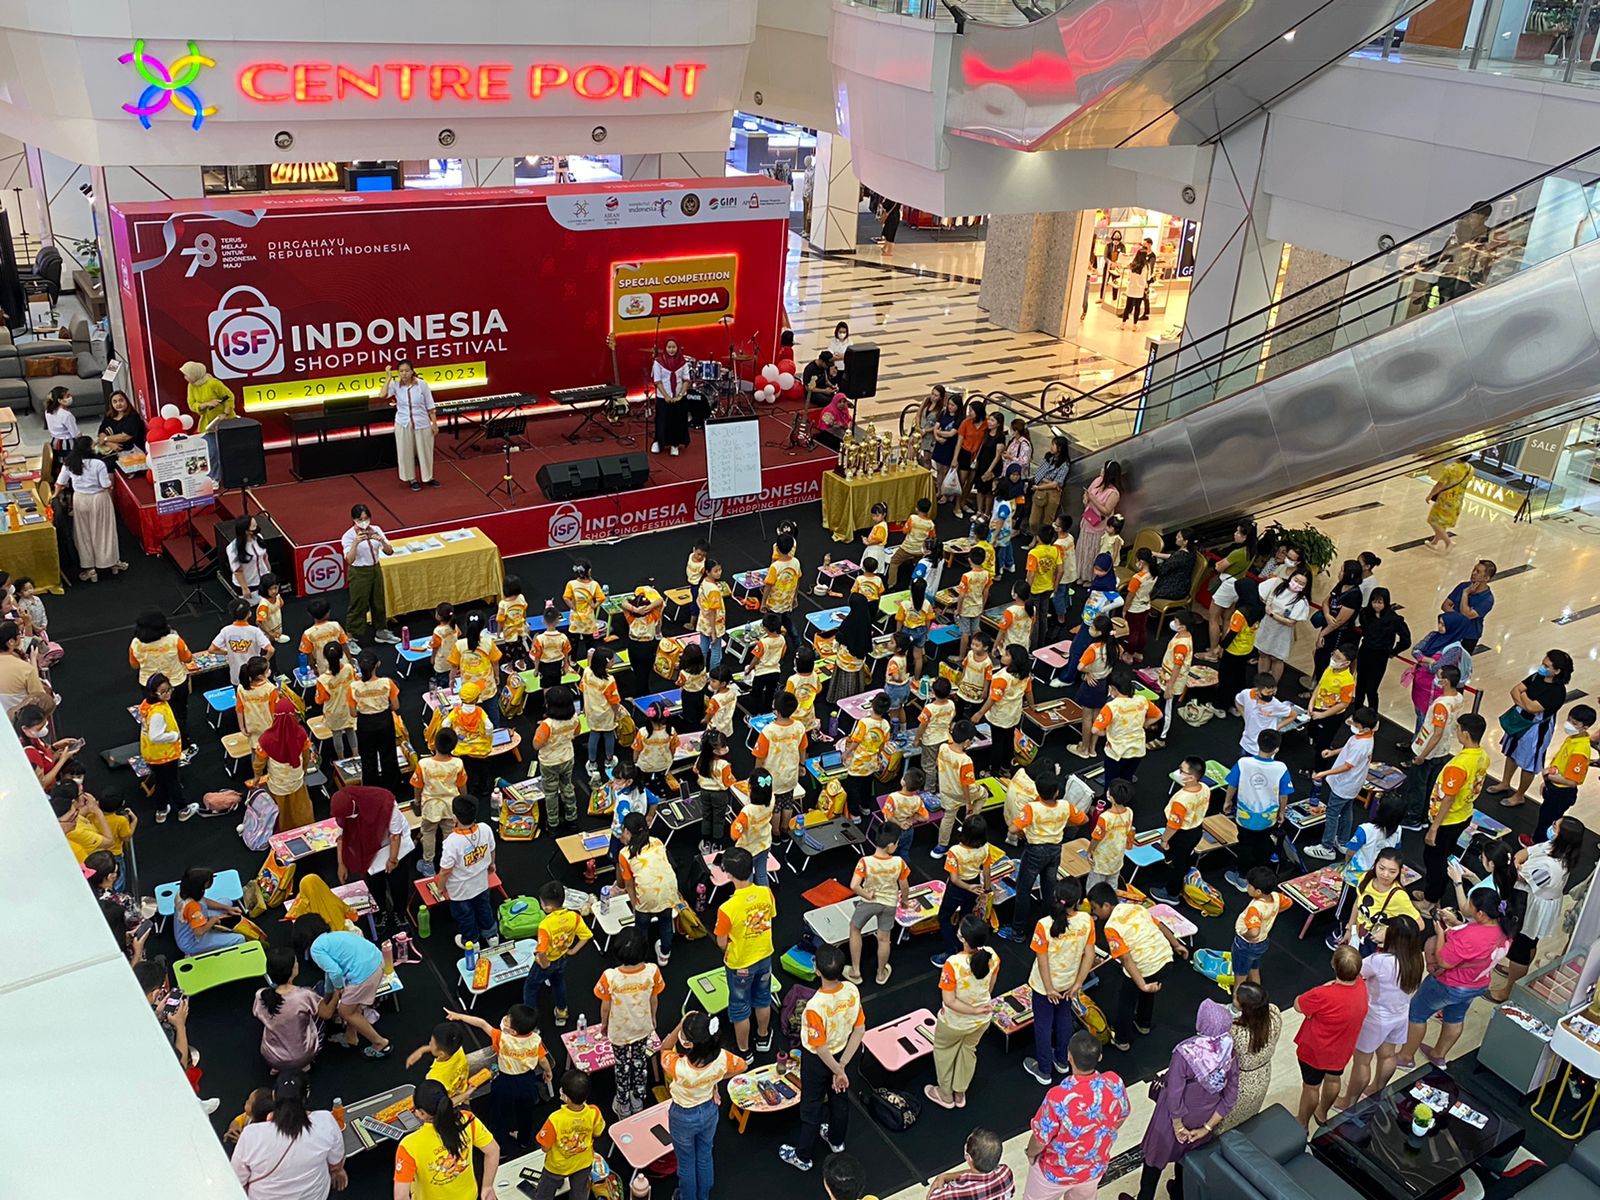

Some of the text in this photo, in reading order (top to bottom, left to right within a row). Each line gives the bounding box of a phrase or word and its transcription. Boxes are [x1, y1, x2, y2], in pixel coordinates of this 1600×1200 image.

[239, 63, 706, 102] CENTRE POINT
[720, 197, 737, 206] GIPI
[221, 249, 245, 257] UNTUK
[267, 238, 345, 251] DIRGAHAYU
[268, 243, 411, 260] REPUBLIK INDONESIA
[222, 255, 257, 263] INDONESIA
[618, 271, 730, 288] SPECIAL COMPETITION
[659, 292, 720, 309] SEMPOA
[291, 308, 508, 352] INDONESIA
[221, 328, 270, 358] ISF
[294, 338, 508, 372] SHOPPING FESTIVAL
[256, 388, 277, 402] 10
[304, 384, 326, 398] 20
[336, 372, 424, 393] AGUSTS
[433, 366, 476, 382] 2023
[1530, 439, 1558, 453] SALE
[585, 503, 688, 532] INDONESIA
[553, 522, 577, 537] ISF
[641, 517, 687, 531] FESTIVAL
[310, 565, 337, 583] ISF
[228, 639, 252, 651] PLAY
